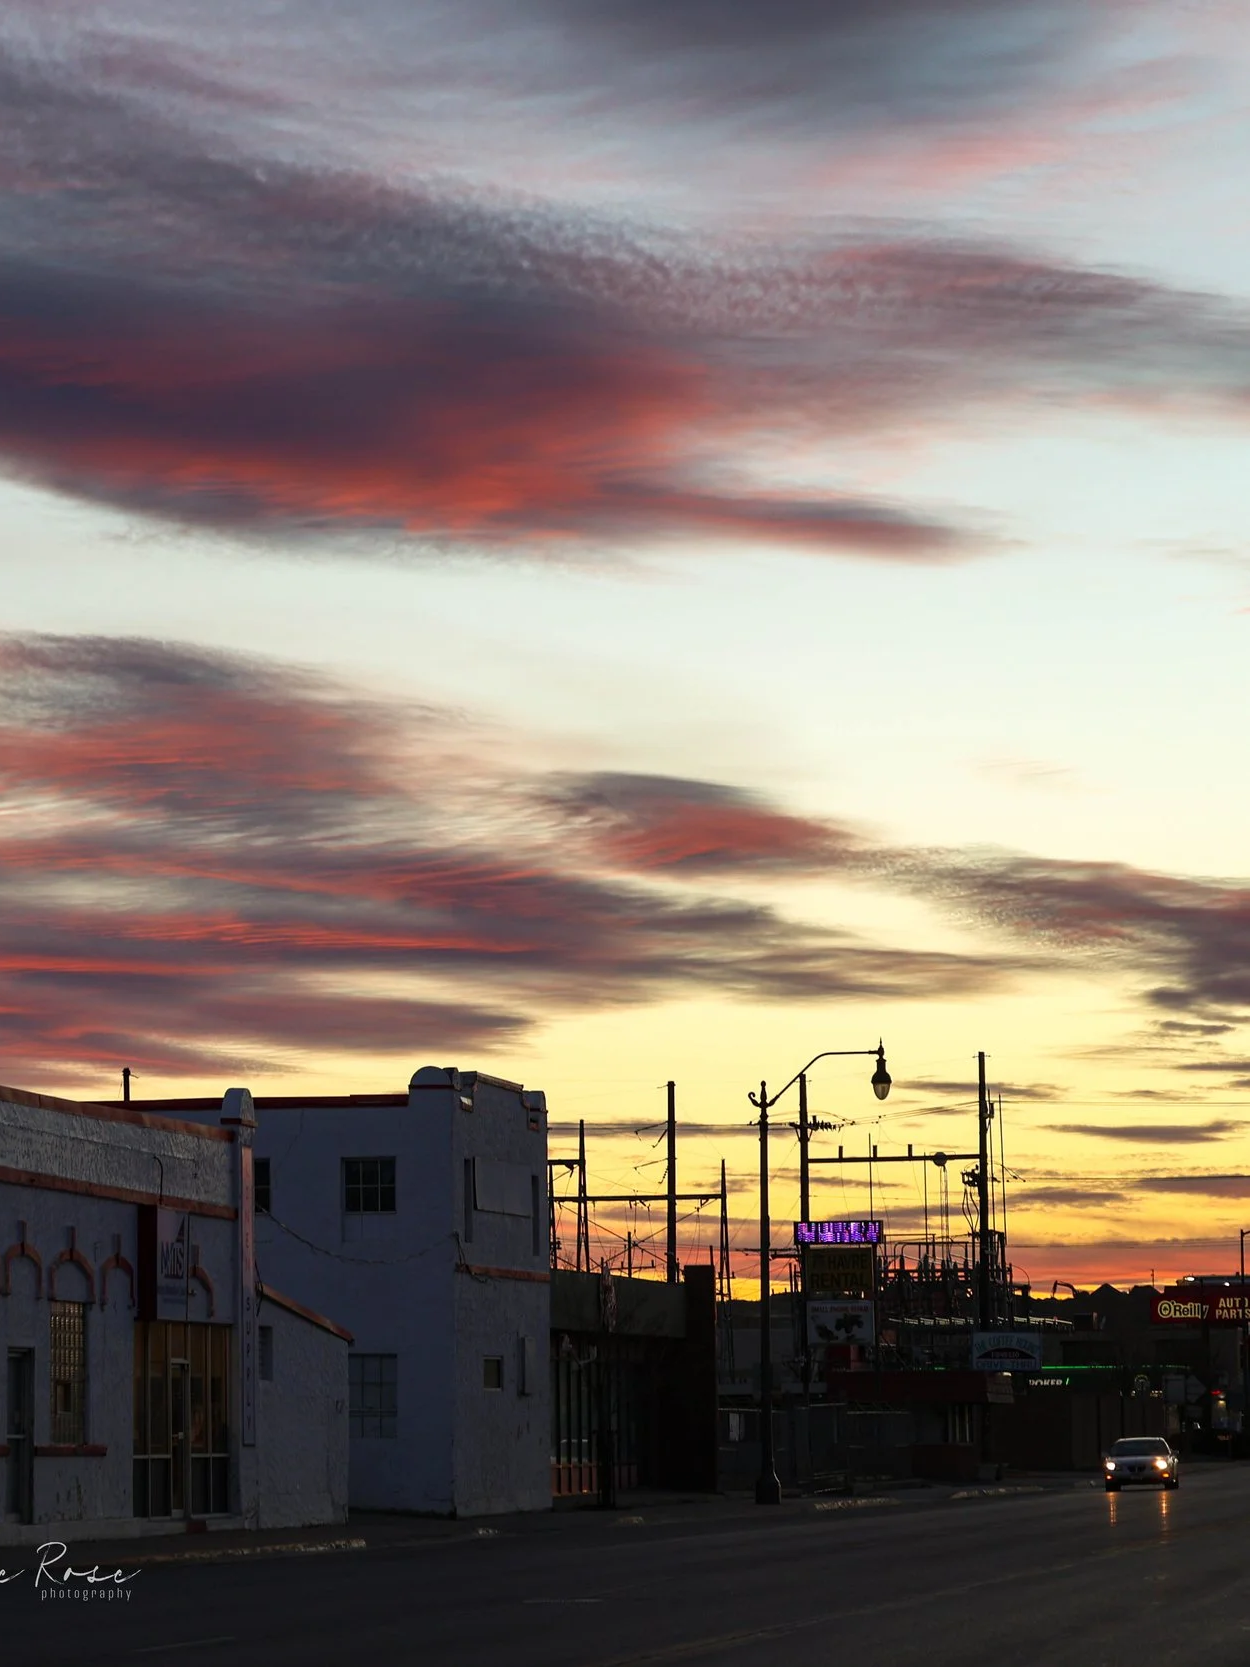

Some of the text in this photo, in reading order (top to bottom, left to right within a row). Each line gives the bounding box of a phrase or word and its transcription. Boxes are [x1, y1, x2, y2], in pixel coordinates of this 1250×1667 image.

[828, 1253, 869, 1270] HAVRE
[810, 1272, 870, 1290] RENTAL
[1157, 1300, 1210, 1320] O'Reilly
